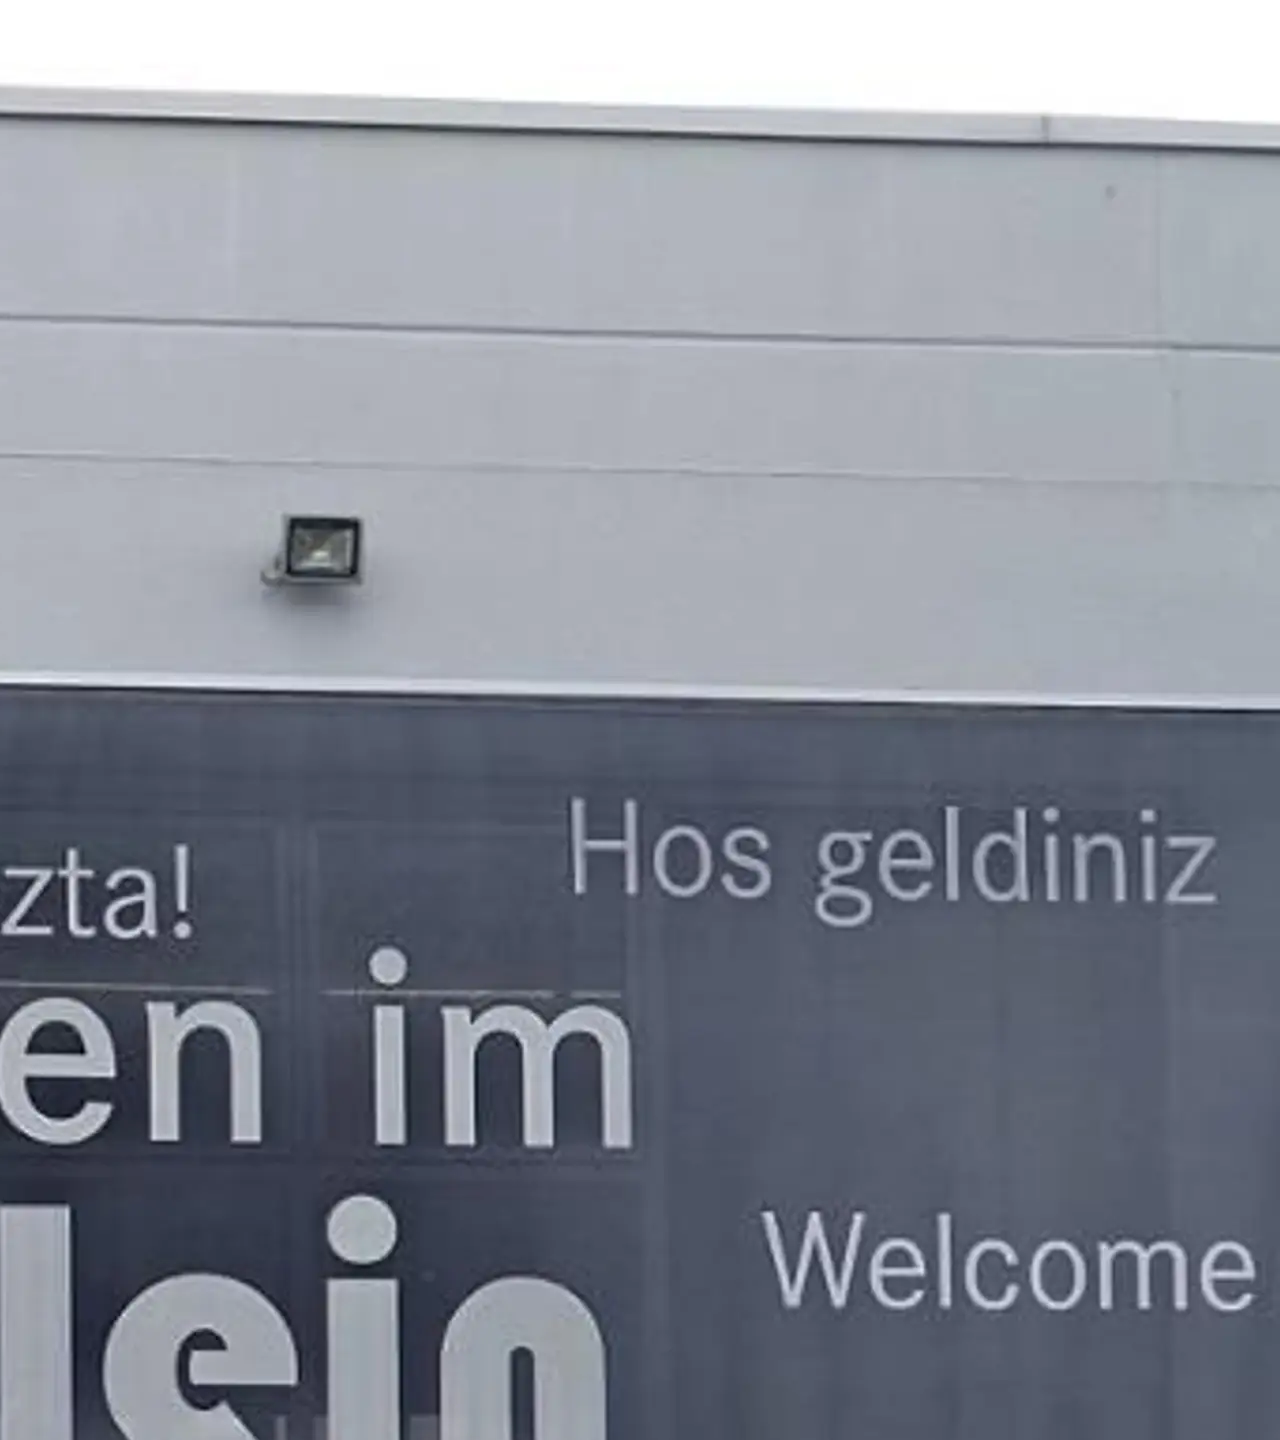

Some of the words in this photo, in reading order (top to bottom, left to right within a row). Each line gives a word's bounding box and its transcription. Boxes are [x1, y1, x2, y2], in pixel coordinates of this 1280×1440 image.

[570, 797, 772, 900] Hos
[814, 805, 1218, 928] geldiniz
[368, 947, 633, 1150] im
[761, 1210, 1257, 1312] Welcome
